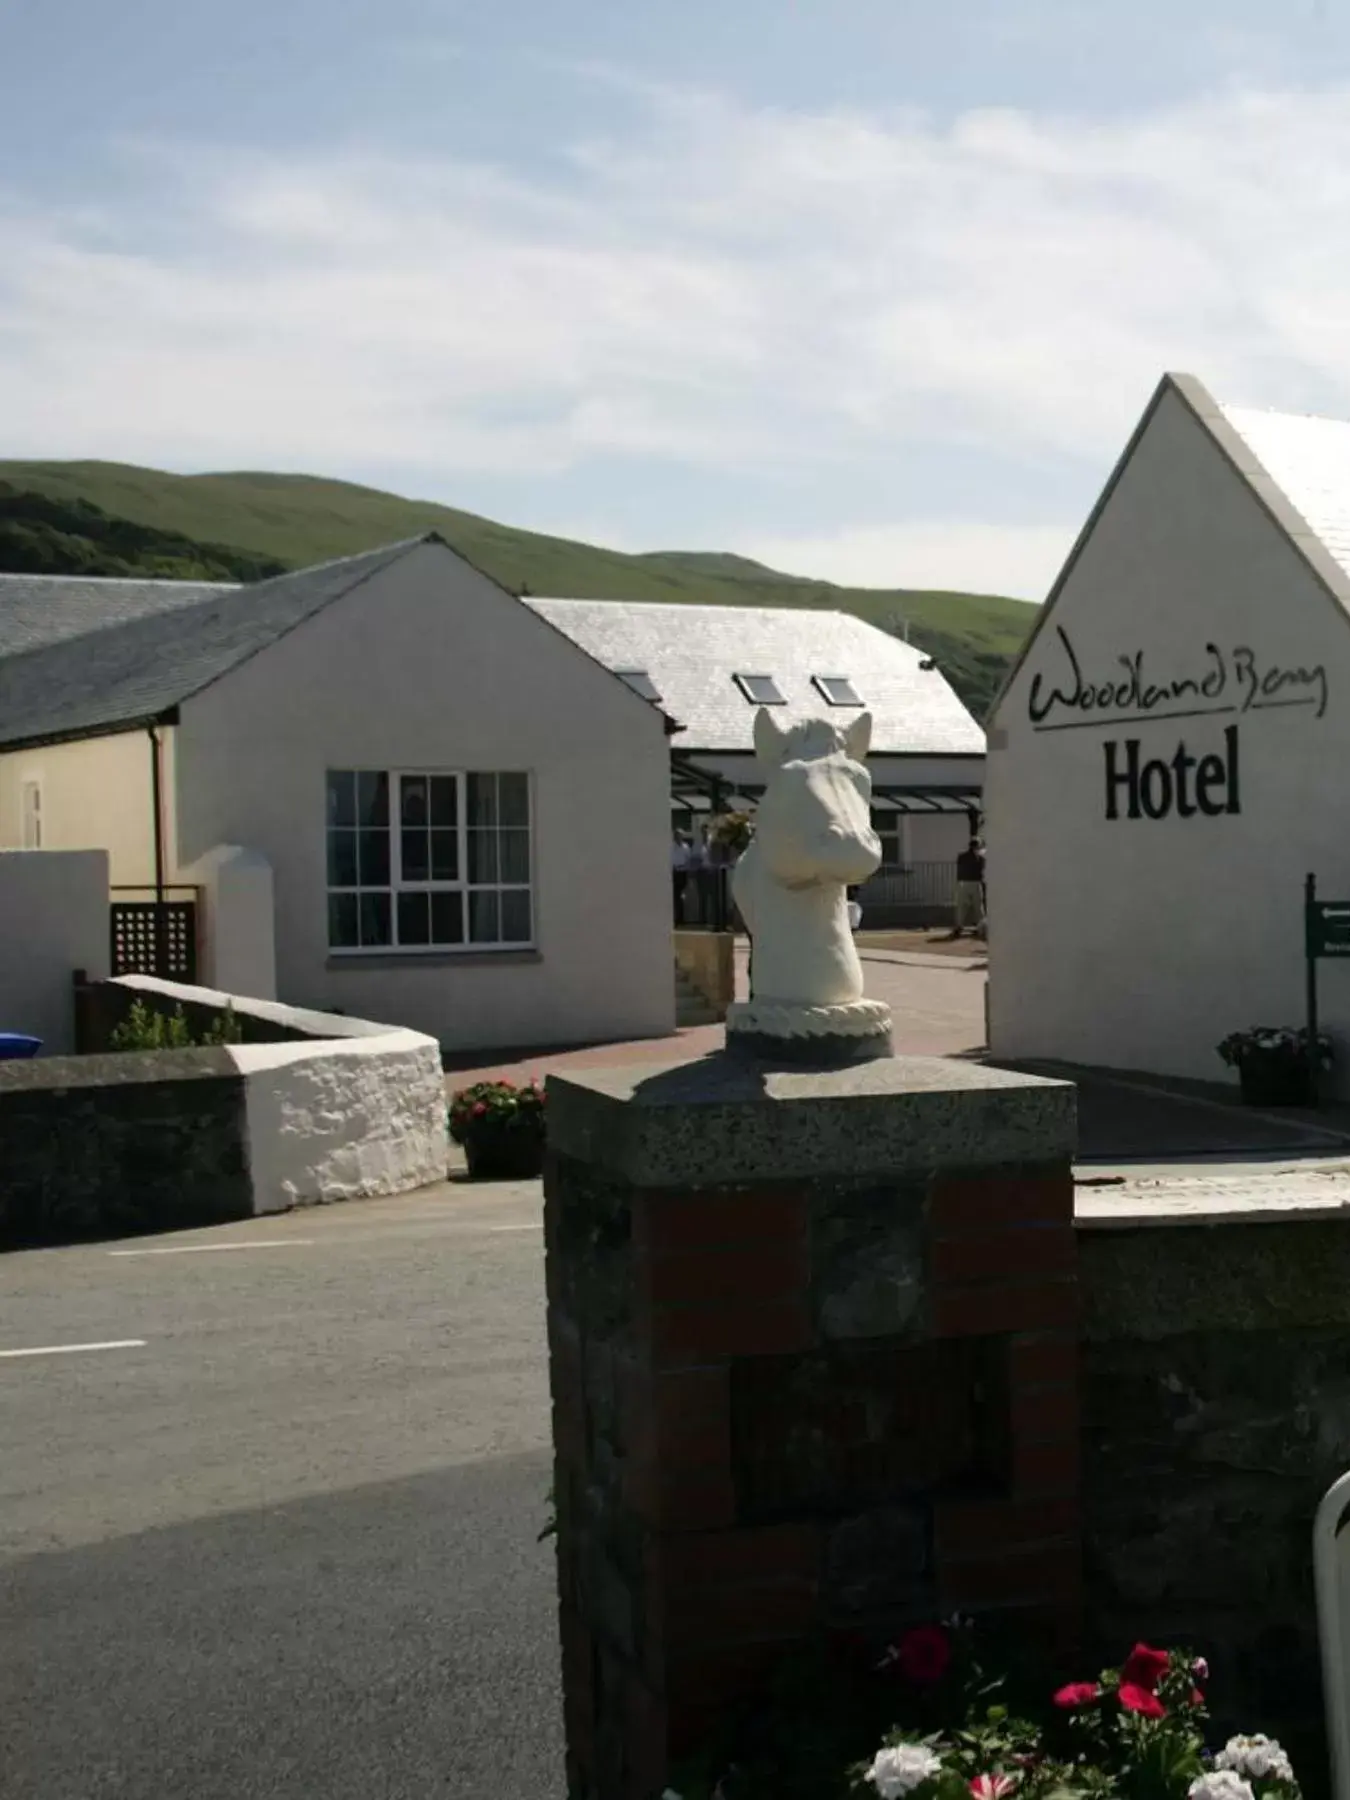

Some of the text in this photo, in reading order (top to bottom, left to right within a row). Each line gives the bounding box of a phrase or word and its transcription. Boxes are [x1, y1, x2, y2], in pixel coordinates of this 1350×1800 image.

[1029, 625, 1327, 722] Woodland Bay
[1103, 724, 1240, 820] Hotel
